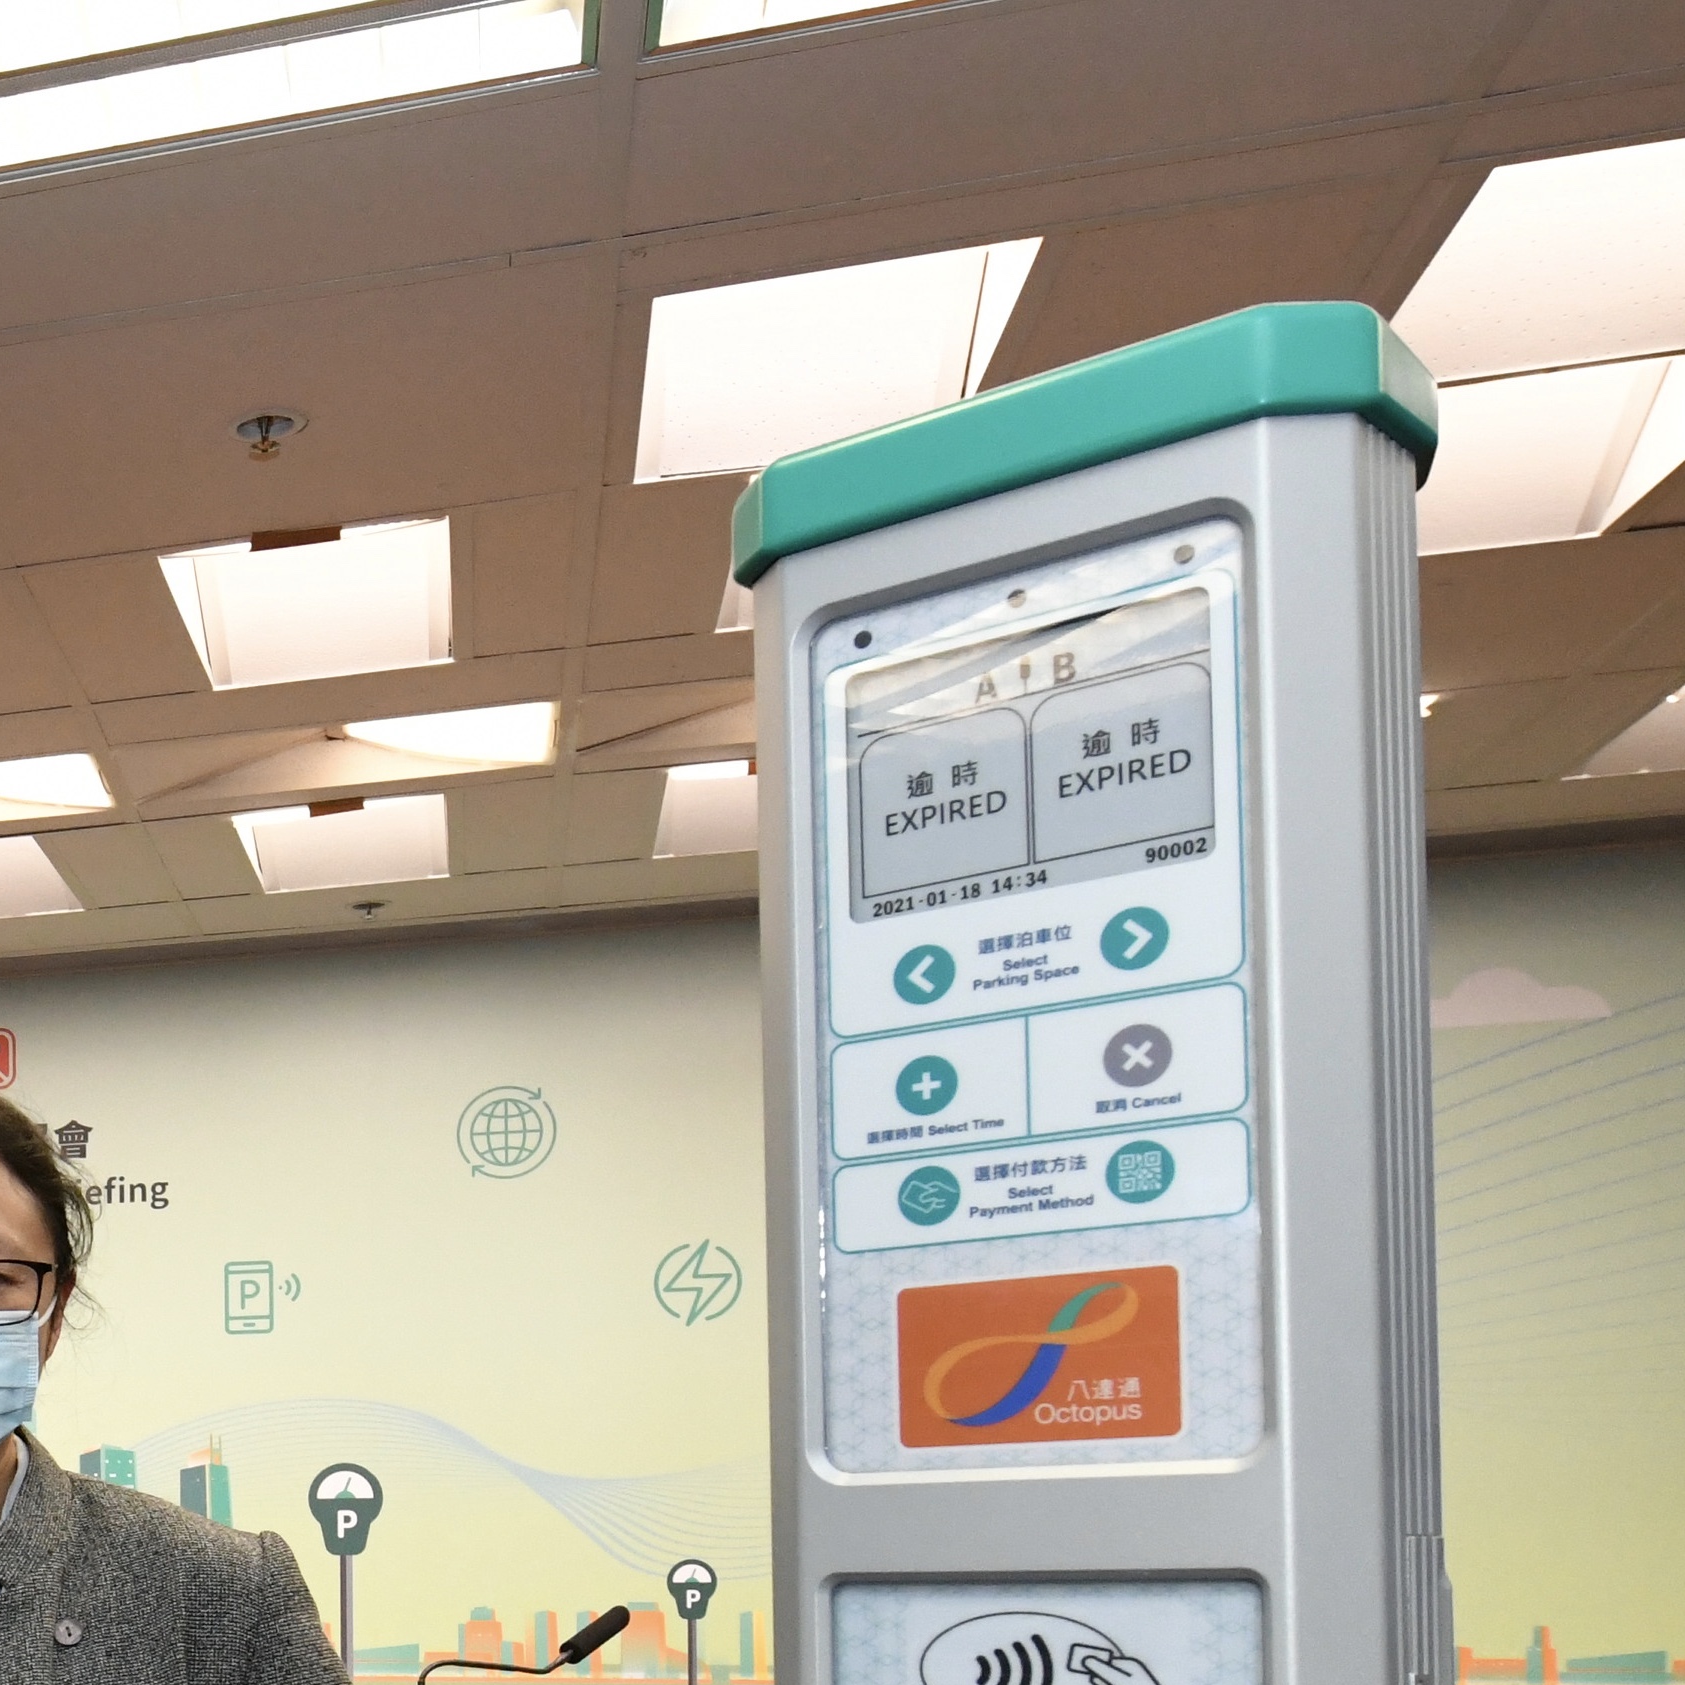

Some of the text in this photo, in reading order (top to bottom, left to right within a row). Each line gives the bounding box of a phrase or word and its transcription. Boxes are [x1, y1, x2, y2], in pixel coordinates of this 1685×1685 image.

[975, 651, 1077, 705] A B
[1059, 748, 1192, 799] EXPIRED
[885, 789, 1007, 837] EXPIRED
[1145, 837, 1208, 864] 90002
[873, 869, 1047, 918] 2021-01-18 14:34
[1003, 954, 1048, 972] Select
[973, 965, 1080, 991] Parking Space
[1132, 1092, 1182, 1109] Cancel
[928, 1121, 969, 1137] Select
[972, 1117, 1005, 1131] Time
[1008, 1184, 1054, 1200] Select
[969, 1195, 1094, 1219] Payment Method
[1067, 1377, 1141, 1401] 八達通
[1034, 1403, 1142, 1426] Octopus
[337, 1510, 357, 1538] P
[686, 1589, 701, 1610] P
